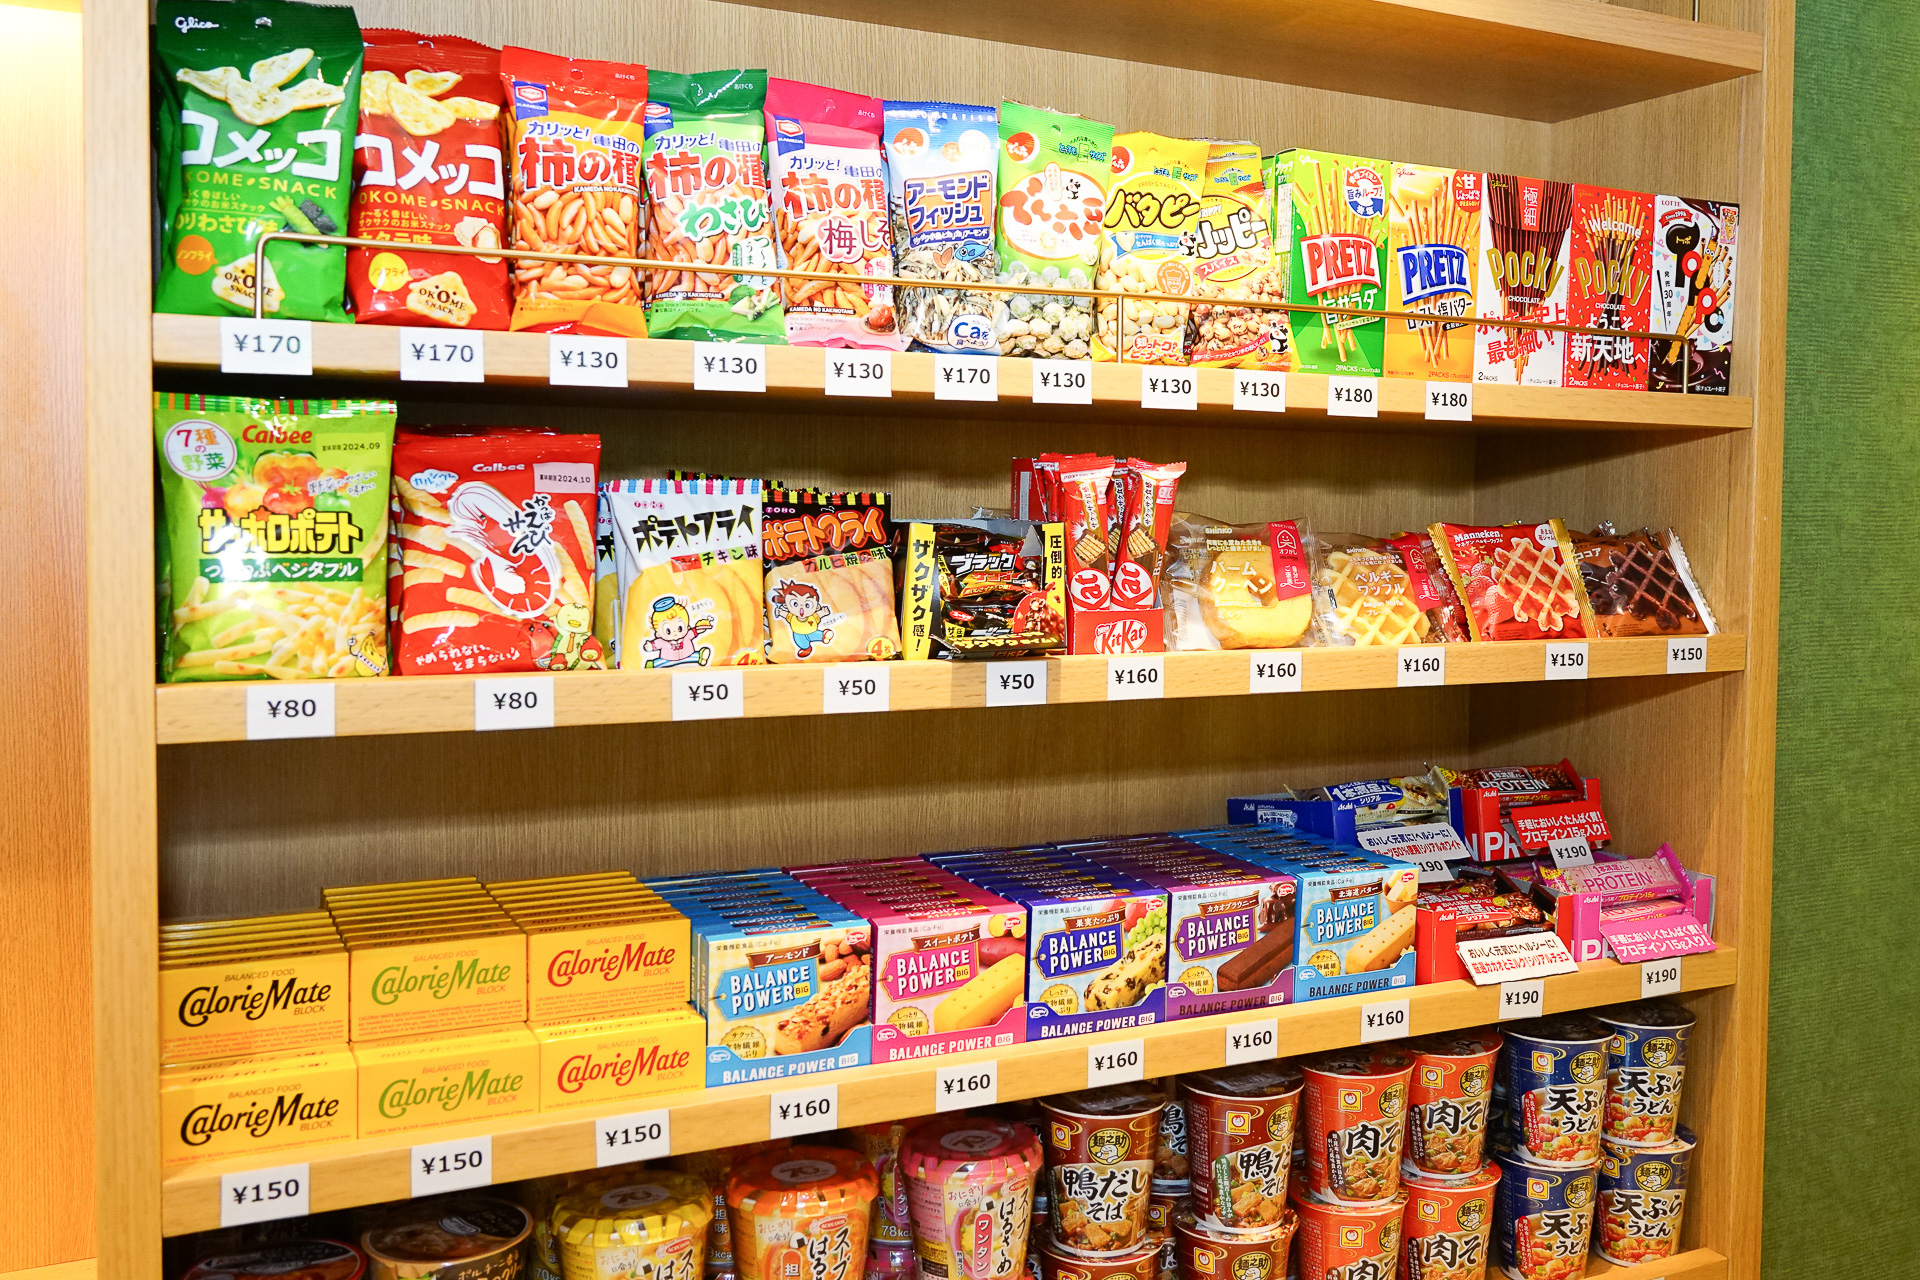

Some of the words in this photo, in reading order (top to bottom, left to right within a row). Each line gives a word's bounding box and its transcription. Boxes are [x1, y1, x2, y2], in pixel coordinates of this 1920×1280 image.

[175, 17, 220, 33] Glico
[529, 122, 591, 140] カリッと!
[181, 109, 342, 182] コメッコ
[655, 133, 715, 151] カリッと!
[354, 134, 504, 200] コメッコ
[519, 136, 640, 191] 柿の種
[790, 156, 841, 171] カリッと!
[646, 151, 765, 202] 柿の種
[1463, 174, 1477, 190] 甘
[259, 177, 337, 200] SNACK
[781, 171, 887, 219] 柿の種
[907, 175, 989, 204] アーモンド
[359, 190, 427, 207] OKOME
[1523, 187, 1538, 227] 極細
[908, 204, 984, 231] フィッシュ
[1103, 188, 1201, 229] バタピー
[1589, 218, 1642, 238] Welcome
[1200, 257, 1238, 274] スパイス
[1306, 239, 1376, 286] PRETZ
[1402, 250, 1467, 295] PRETZ
[419, 287, 467, 311] OKOME
[425, 299, 455, 315] SNACK
[1507, 295, 1541, 304] CHOCOLATE
[1595, 303, 1626, 311] CHOCOLATE
[234, 335, 300, 353] ¥170
[412, 344, 473, 362] ¥170
[1571, 333, 1646, 364] 新天地へ
[561, 351, 617, 368] ¥130
[704, 357, 757, 374] ¥130
[1335, 364, 1358, 373] 2PACKS
[834, 363, 883, 379] ¥130
[943, 368, 990, 383] ¥170
[1041, 373, 1085, 388] ¥130
[1150, 378, 1191, 394] ¥130
[1241, 382, 1279, 397] ¥130
[1335, 388, 1372, 402] ¥180
[1432, 393, 1467, 407] ¥180
[176, 427, 220, 448] 7種
[242, 424, 313, 445] Calbee
[342, 442, 381, 451] 2024.09
[181, 453, 227, 473] 野菜
[472, 462, 526, 473] Calbee
[558, 474, 591, 484] 2024.10
[632, 504, 755, 554] ポテトフライ
[1453, 529, 1501, 543] Manneken
[1049, 535, 1063, 580] 圧倒的
[1460, 545, 1488, 558] いちご
[950, 552, 1017, 578] ブラック
[1210, 560, 1257, 576] バーム
[1355, 570, 1404, 583] ベルギー
[911, 539, 934, 652] ザクザク感!
[1212, 577, 1273, 596] クーヘン
[1357, 583, 1405, 597] ワッフル
[1099, 620, 1145, 654] KitKat
[871, 639, 892, 656] 4枚
[1673, 648, 1702, 660] ¥150
[1404, 658, 1439, 672] ¥160
[1551, 653, 1583, 666] ¥150
[1115, 669, 1157, 684] ¥160
[1257, 663, 1296, 677] ¥160
[839, 680, 875, 695] ¥50
[1000, 674, 1034, 689] ¥50
[494, 692, 537, 709] ¥80
[689, 684, 728, 701] ¥50
[268, 700, 316, 717] ¥80
[1332, 783, 1398, 801] 1本満足バー
[1359, 795, 1382, 805] シリアル
[1483, 789, 1497, 798] Asahi
[1337, 803, 1354, 811] Asahi
[1517, 811, 1603, 831] 手軽においしくたんぱく質!
[1366, 829, 1452, 847] おいしく元気に!ヘルシーに!
[1522, 823, 1607, 844] プロテイン15g入り!
[1556, 846, 1587, 859] ¥190
[1415, 860, 1443, 874] 190
[1584, 871, 1653, 893] PROTEIN
[1338, 885, 1379, 899] 北海道バター
[1584, 896, 1599, 904] Asahi
[1206, 900, 1257, 914] カカオブラウニー
[1075, 913, 1120, 928] 果実たっぷり
[1438, 912, 1455, 921] Asahi
[1187, 914, 1250, 939] BALANCE
[1609, 924, 1703, 945] 手軽においしくたんぱく質!
[924, 933, 975, 948] スイートポテト
[1049, 930, 1117, 955] BALANCE
[1188, 932, 1237, 957] POWER
[1467, 939, 1559, 959] おいしく元気に!ヘルシーに!
[1617, 935, 1711, 958] プロテイン15g入り!
[765, 948, 810, 963] アーモンド
[897, 950, 970, 976] BALANCE
[1050, 949, 1103, 974] POWER
[643, 967, 671, 977] BLOCK
[731, 966, 811, 994] BALANCE
[1647, 968, 1676, 984] ¥190
[477, 984, 506, 995] BLOCK
[898, 968, 956, 996] POWER
[733, 986, 794, 1015] POWER
[795, 985, 810, 995] BIG
[1506, 991, 1538, 1005] ¥190
[294, 1004, 326, 1016] BLOCK
[1367, 1010, 1403, 1027] ¥160
[1041, 1021, 1094, 1038] BALANCE
[1096, 1016, 1136, 1032] POWER
[889, 1044, 945, 1061] BALANCE
[949, 1035, 992, 1053] POWER
[1233, 1031, 1271, 1049] ¥160
[1095, 1052, 1137, 1070] ¥160
[723, 1066, 785, 1084] BALANCE
[788, 1058, 835, 1076] POWER
[944, 1074, 990, 1094] ¥160
[1615, 1068, 1684, 1098] 天ぷら
[780, 1099, 829, 1119] ¥160
[1632, 1098, 1674, 1116] うどん
[1561, 1116, 1599, 1135] うどん
[606, 1124, 661, 1146] ¥150
[422, 1151, 482, 1174] ¥150
[233, 1180, 299, 1204] ¥150
[1062, 1165, 1149, 1201] 鴨だし
[948, 1185, 984, 1201] おにぎり
[1086, 1200, 1124, 1222] そば
[1610, 1190, 1683, 1221] 天ぷら
[996, 1197, 1015, 1275] はるさめ
[1627, 1220, 1671, 1238] うどん
[976, 1220, 990, 1273] ワンタン
